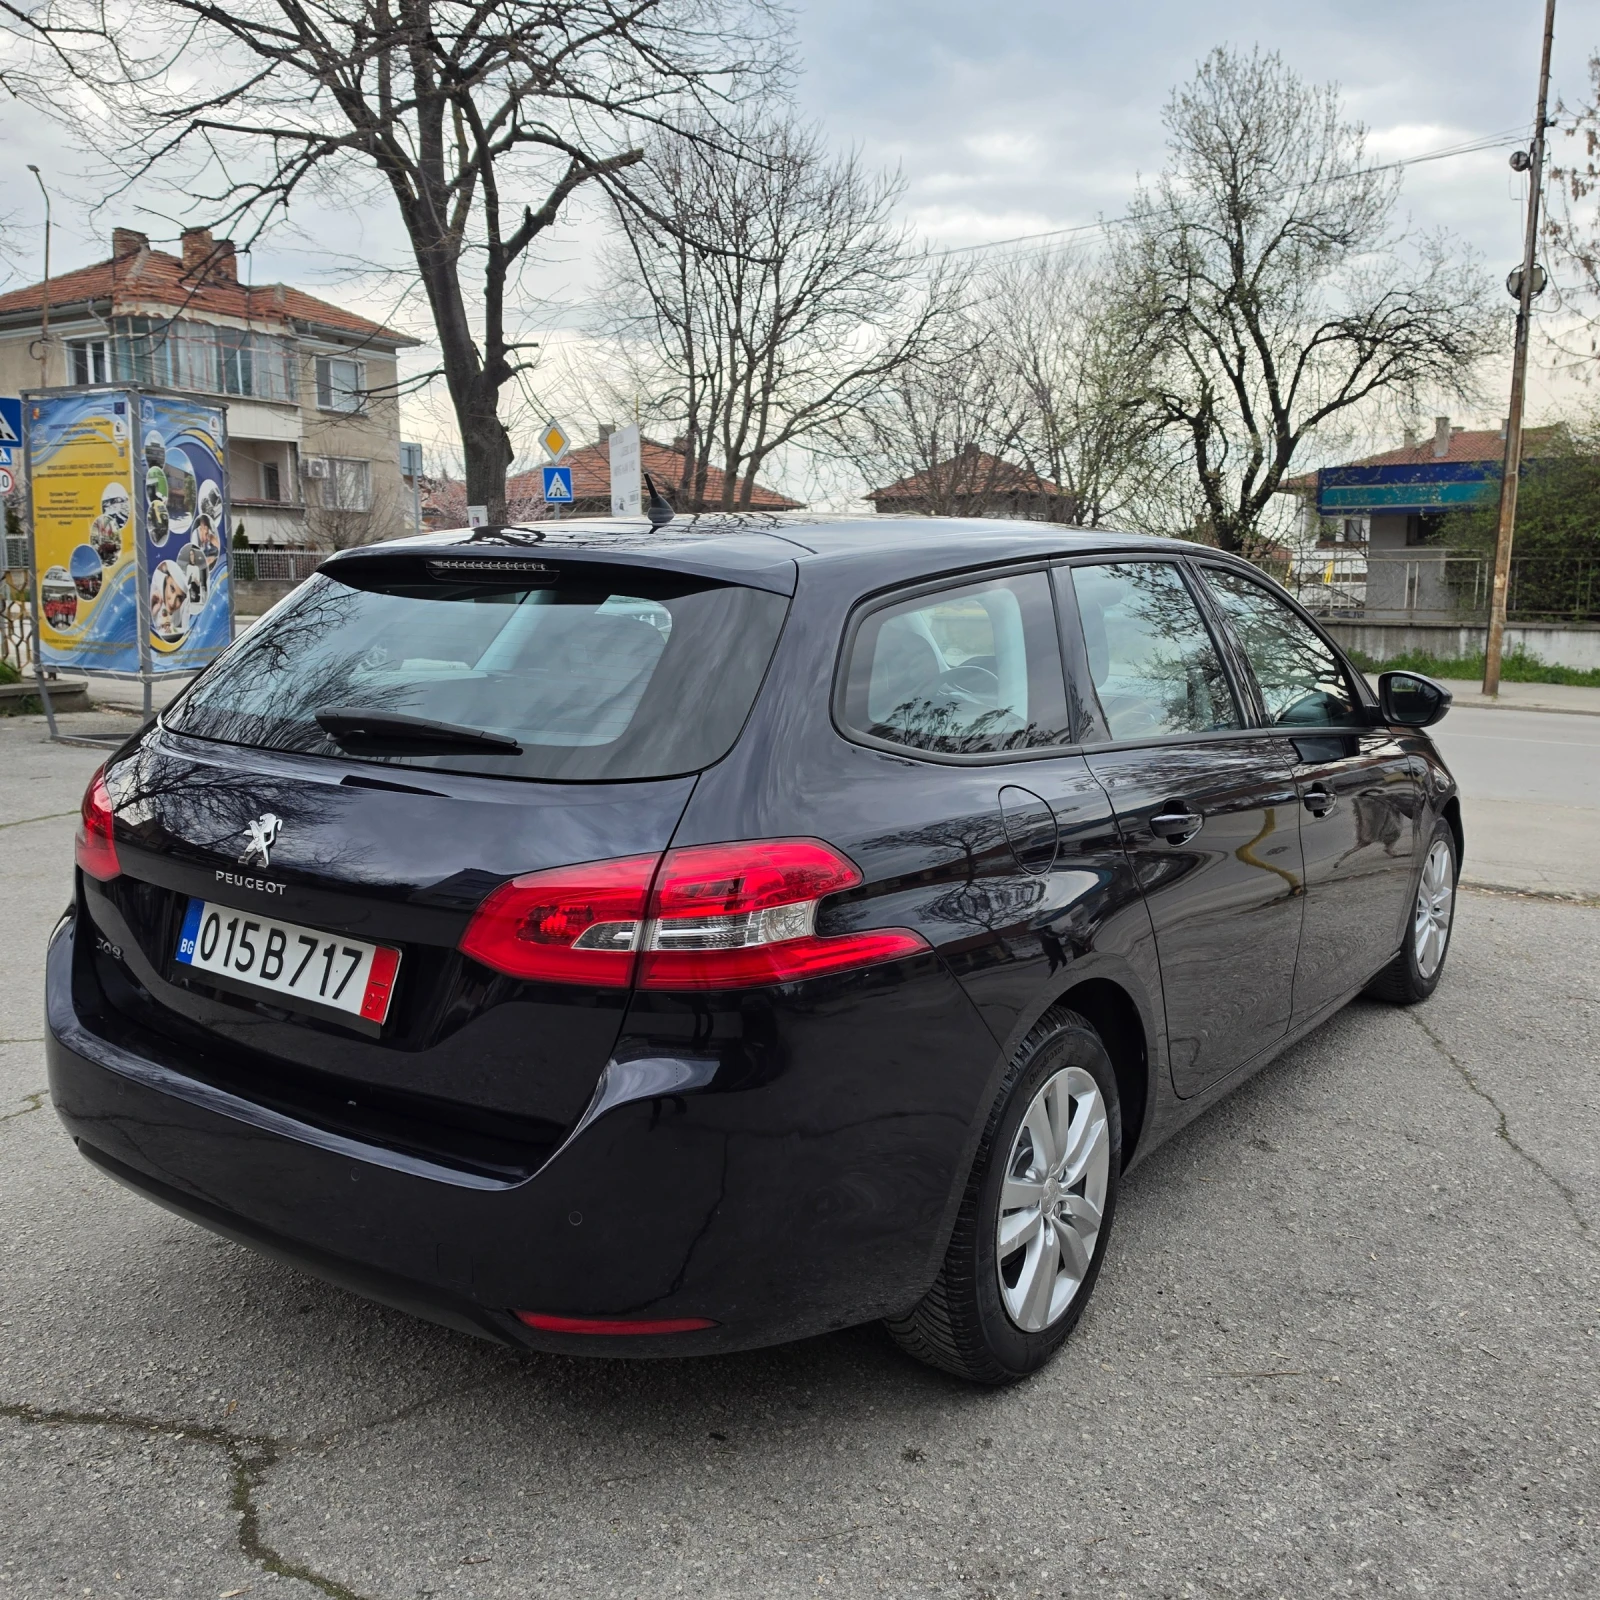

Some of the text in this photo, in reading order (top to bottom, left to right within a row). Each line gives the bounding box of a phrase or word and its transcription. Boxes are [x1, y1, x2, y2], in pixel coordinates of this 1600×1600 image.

[215, 870, 287, 896] PEUGEOT
[180, 938, 195, 955] BG
[200, 912, 363, 1000] 015B717
[365, 993, 385, 1012] 27
[1028, 1042, 1066, 1085] Quadraxer
